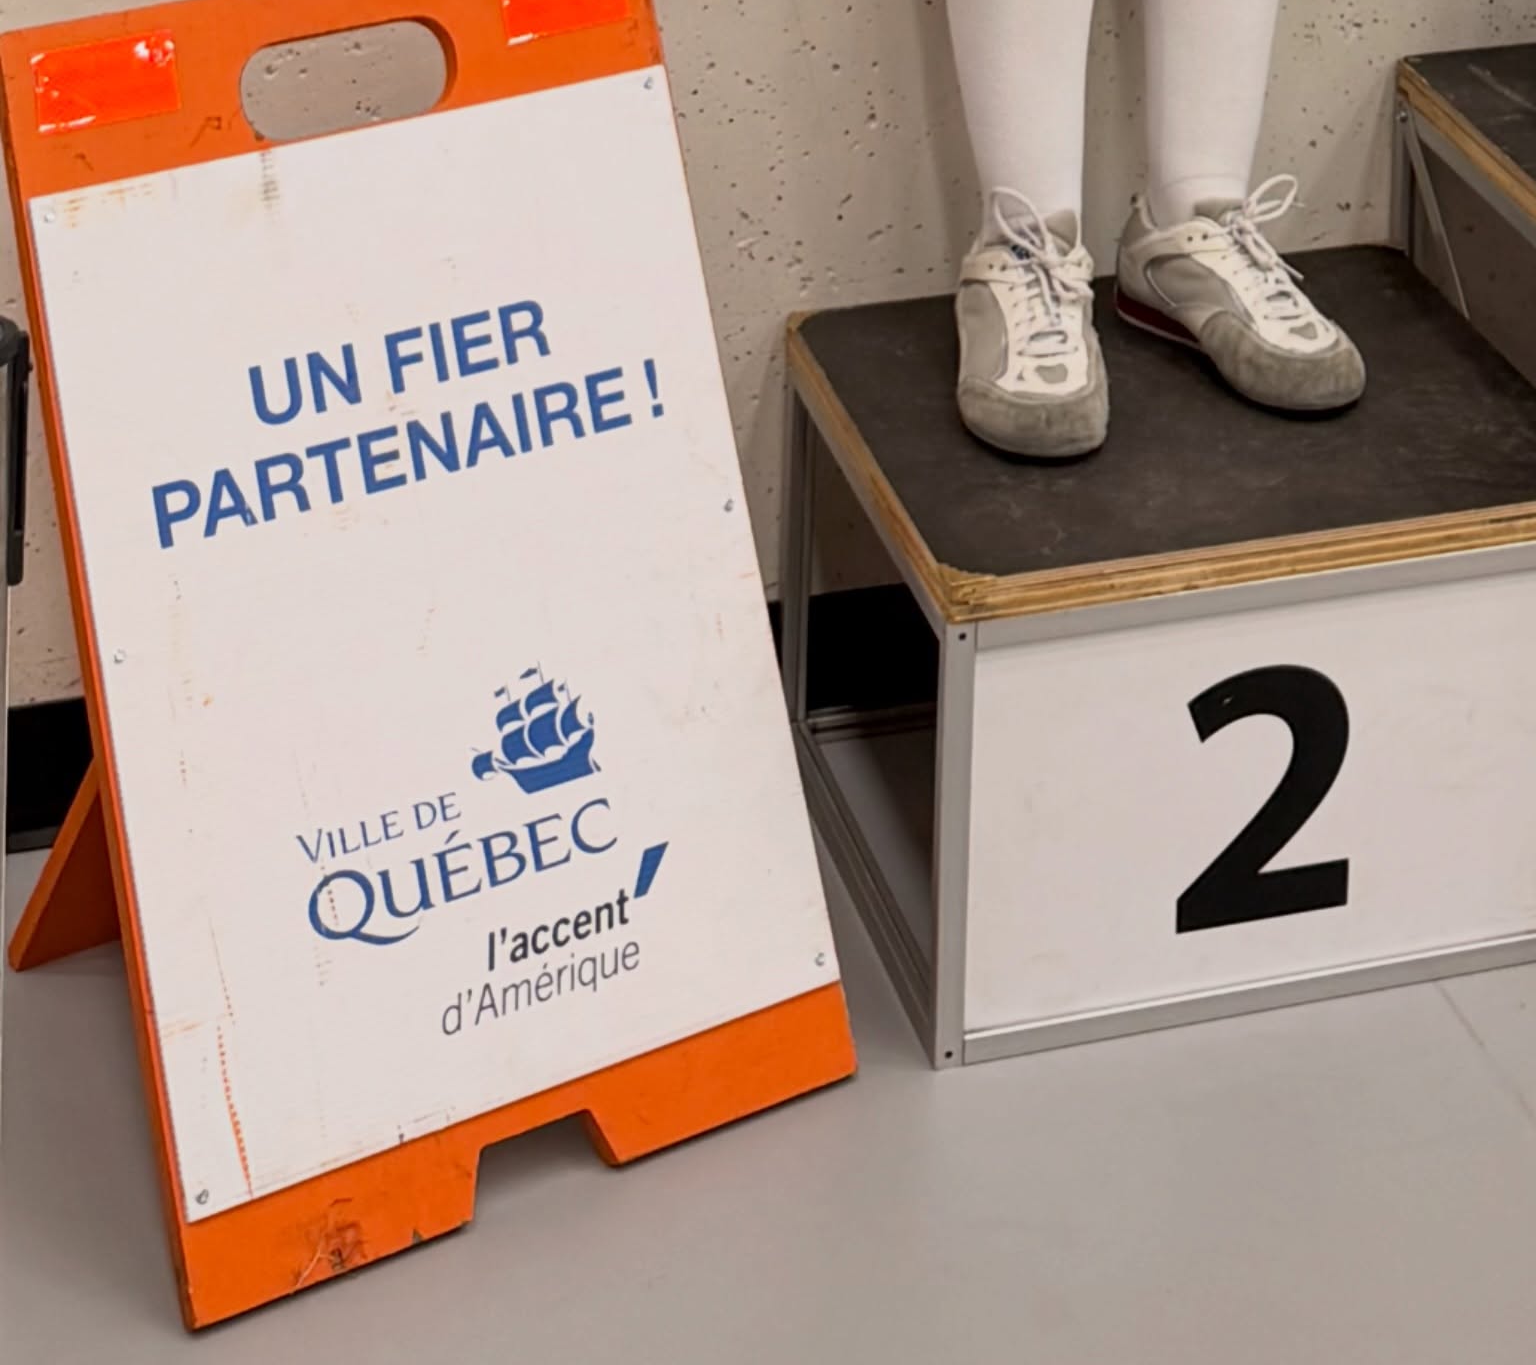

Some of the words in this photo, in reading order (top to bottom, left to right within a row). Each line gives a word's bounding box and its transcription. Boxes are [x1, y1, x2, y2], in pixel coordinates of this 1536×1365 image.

[249, 344, 362, 425] UN
[385, 300, 550, 393] FIER
[413, 792, 462, 829] DE
[1176, 665, 1349, 934] 2
[309, 798, 618, 945] QUÉBEC
[488, 889, 629, 971] l'accent
[442, 941, 640, 1036] d'Amérique
